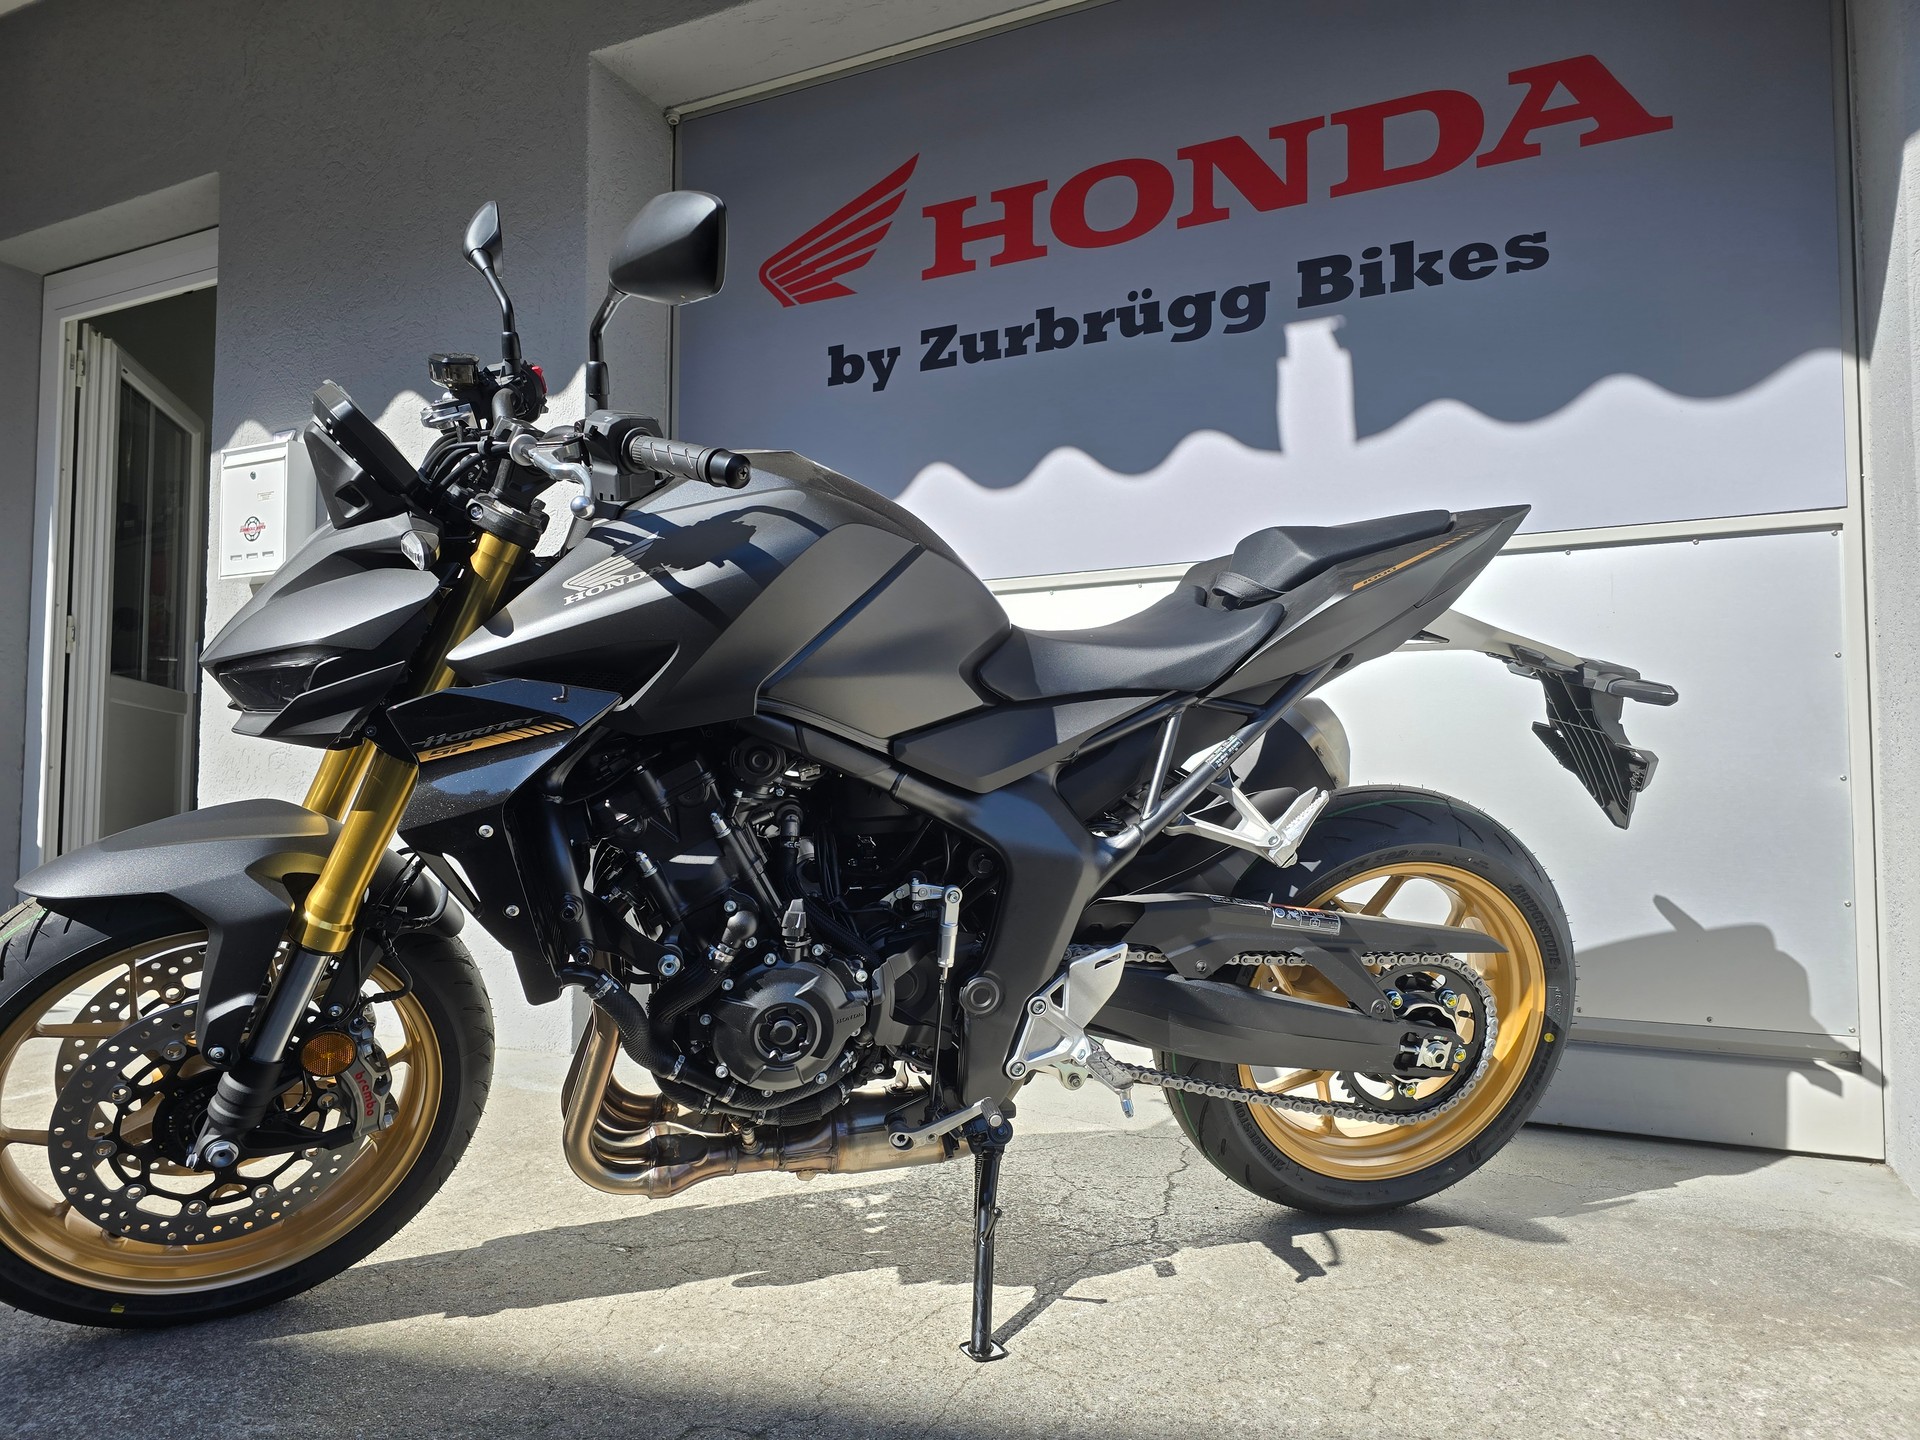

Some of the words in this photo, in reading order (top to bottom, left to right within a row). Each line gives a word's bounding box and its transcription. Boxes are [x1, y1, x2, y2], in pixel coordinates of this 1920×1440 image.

[921, 54, 1673, 281] HONDA
[827, 344, 899, 391] by
[920, 277, 1271, 371] Zurbrügg
[1296, 231, 1550, 309] Bikes
[428, 741, 474, 759] SP
[355, 1071, 377, 1117] brembo
